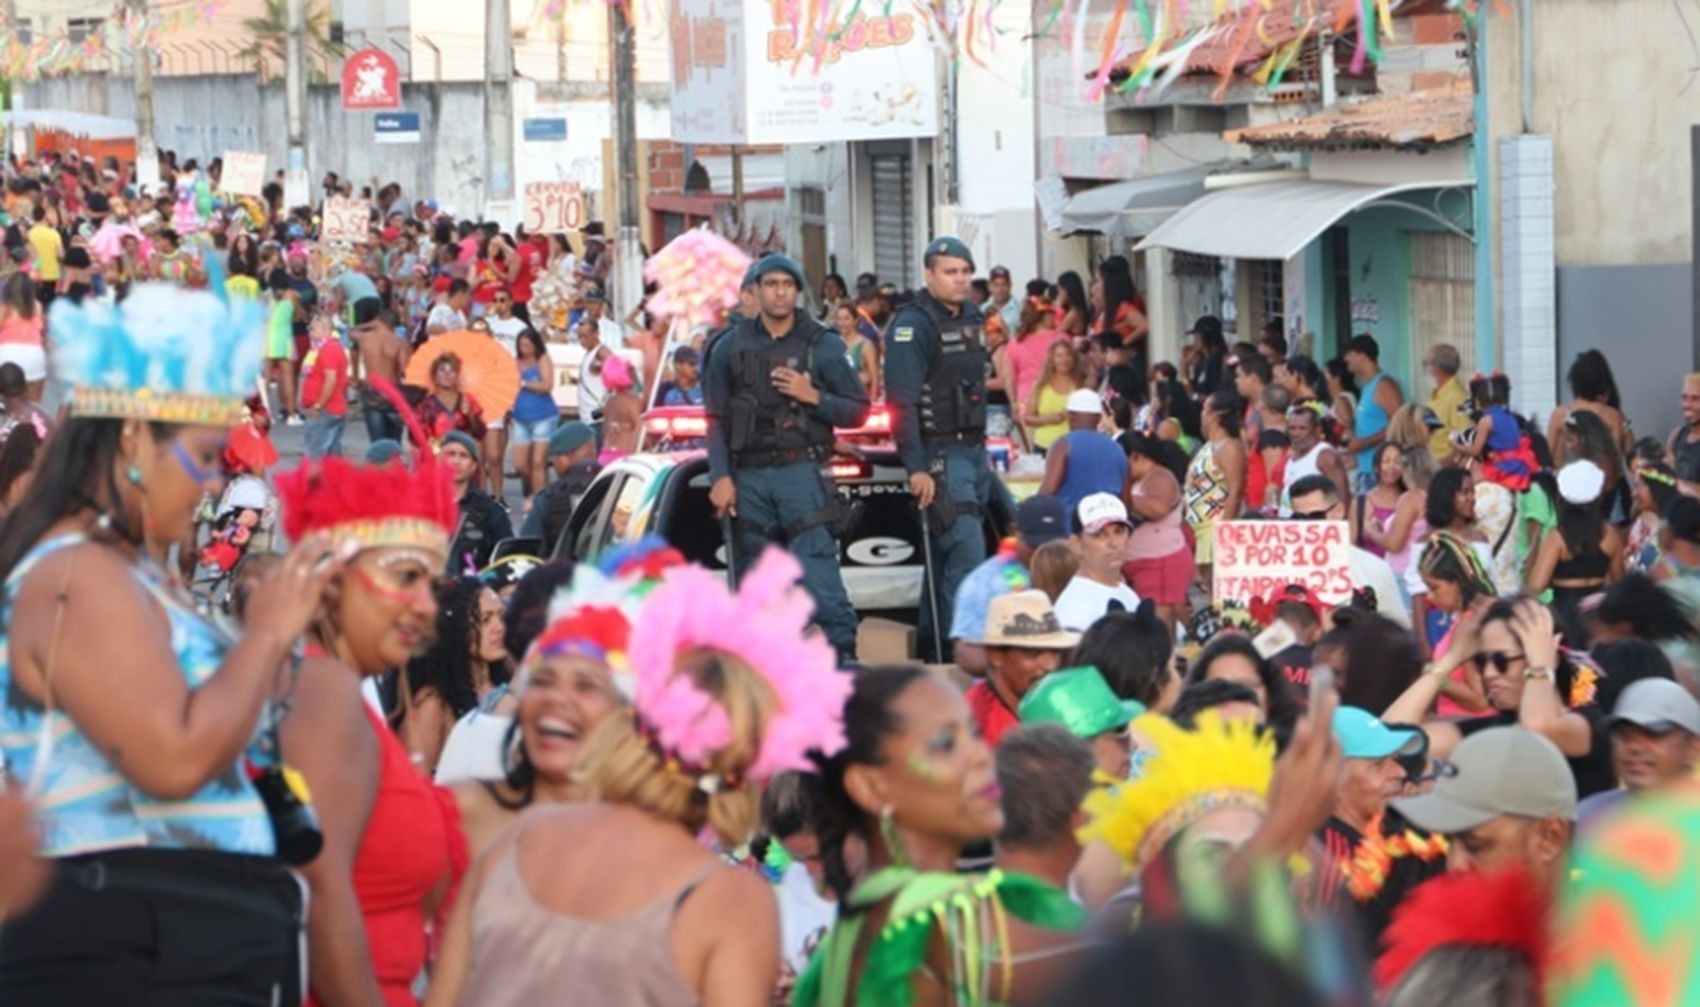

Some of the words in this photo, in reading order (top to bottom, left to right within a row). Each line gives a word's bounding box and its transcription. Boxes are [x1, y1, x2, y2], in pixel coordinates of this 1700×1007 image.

[1218, 523, 1341, 545] DEVASSA
[1220, 545, 1237, 566] 3
[1245, 545, 1287, 566] POR
[1292, 545, 1329, 566] 10
